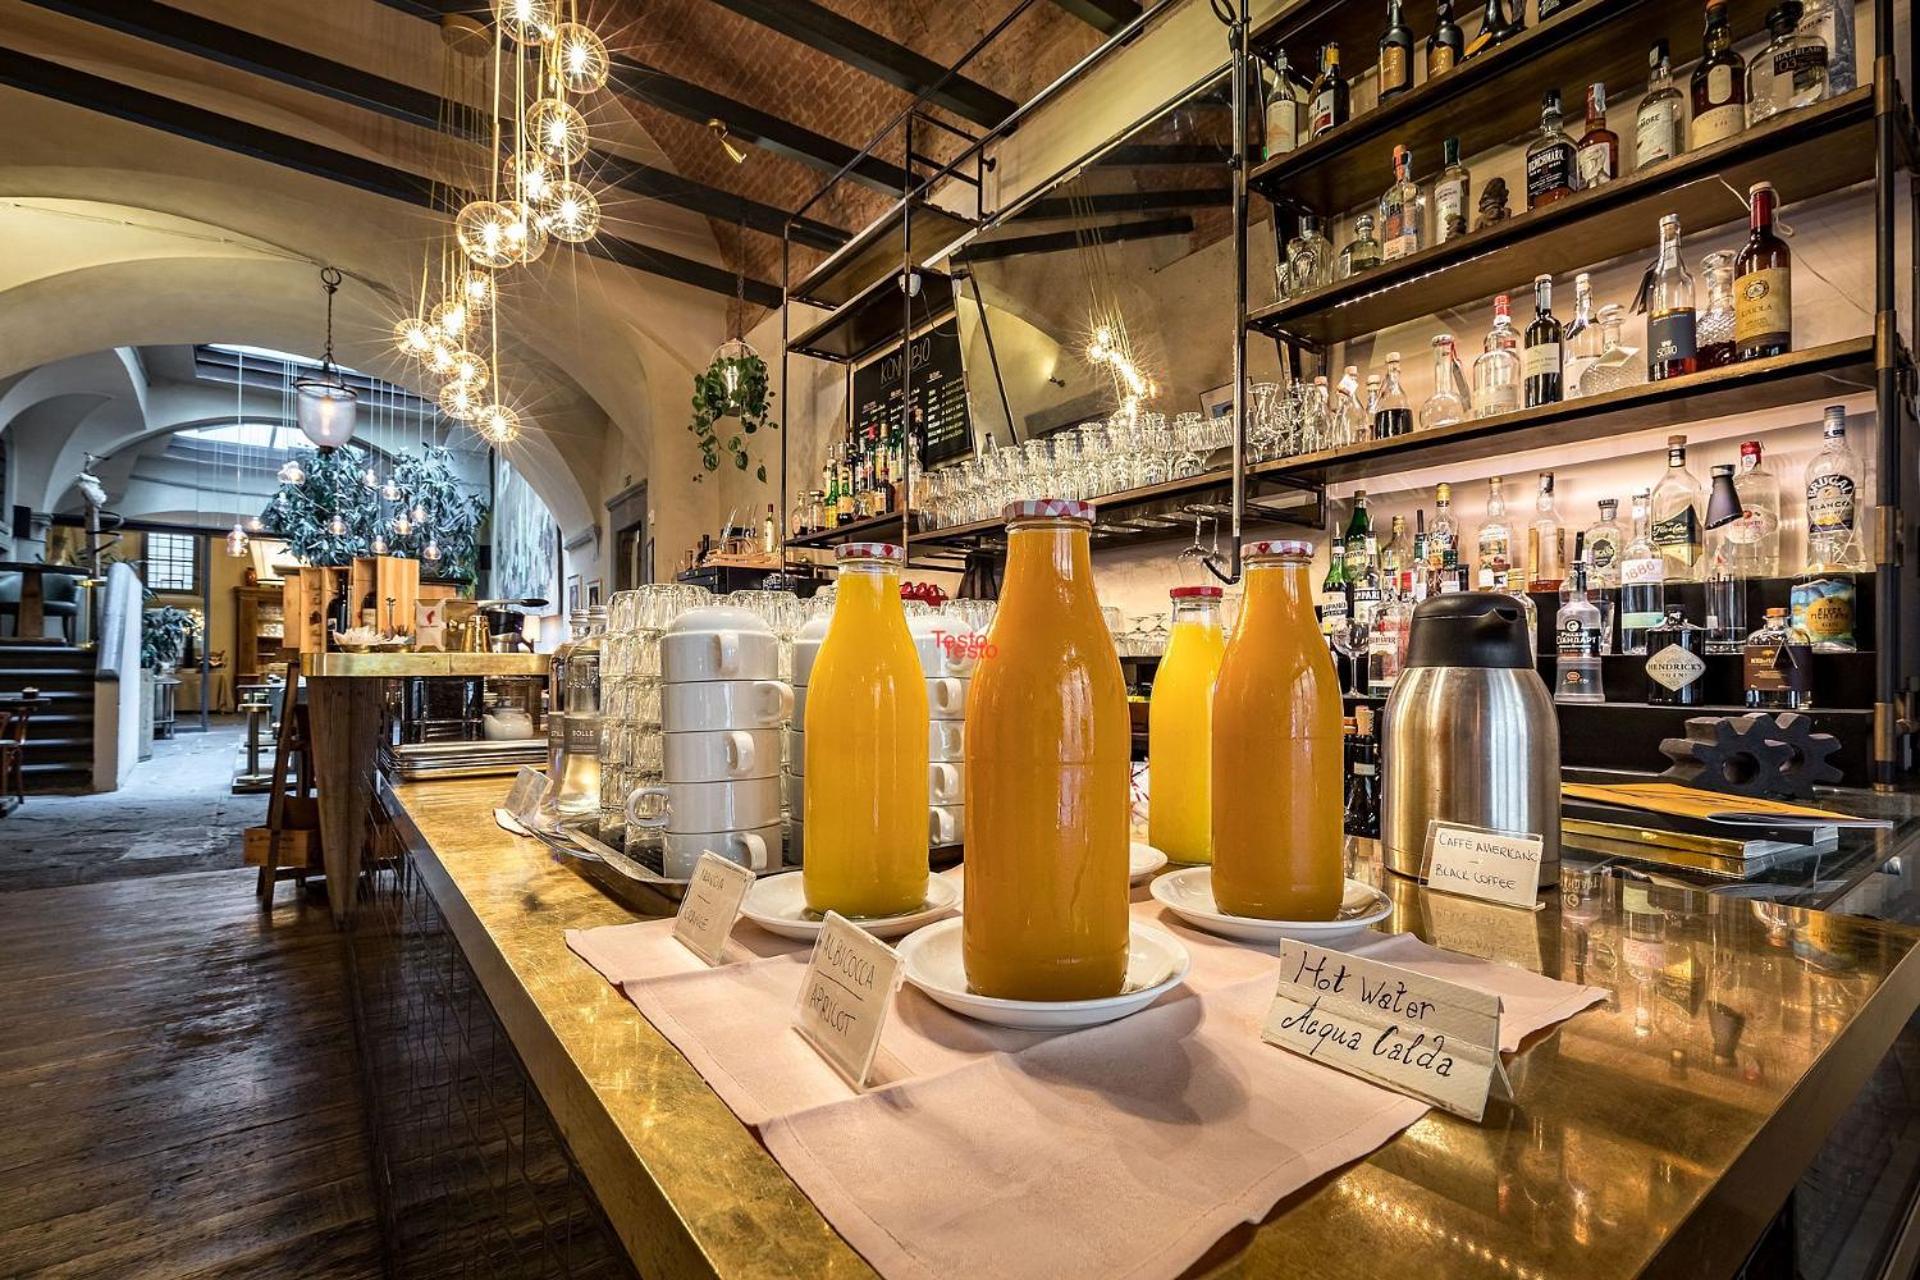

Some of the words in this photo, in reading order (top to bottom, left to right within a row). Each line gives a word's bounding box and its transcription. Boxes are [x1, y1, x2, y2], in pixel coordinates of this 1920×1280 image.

[1808, 477, 1852, 497] BRUGAL
[1435, 863, 1469, 880] BLACK
[1474, 871, 1517, 889] COFFEE
[823, 933, 876, 991] ALBICOCCA
[1294, 951, 1352, 993] Hot
[1361, 976, 1436, 1020] Water
[808, 982, 857, 1037] APRICOT
[1280, 996, 1363, 1055] Acqua
[1372, 1024, 1454, 1077] Calda
